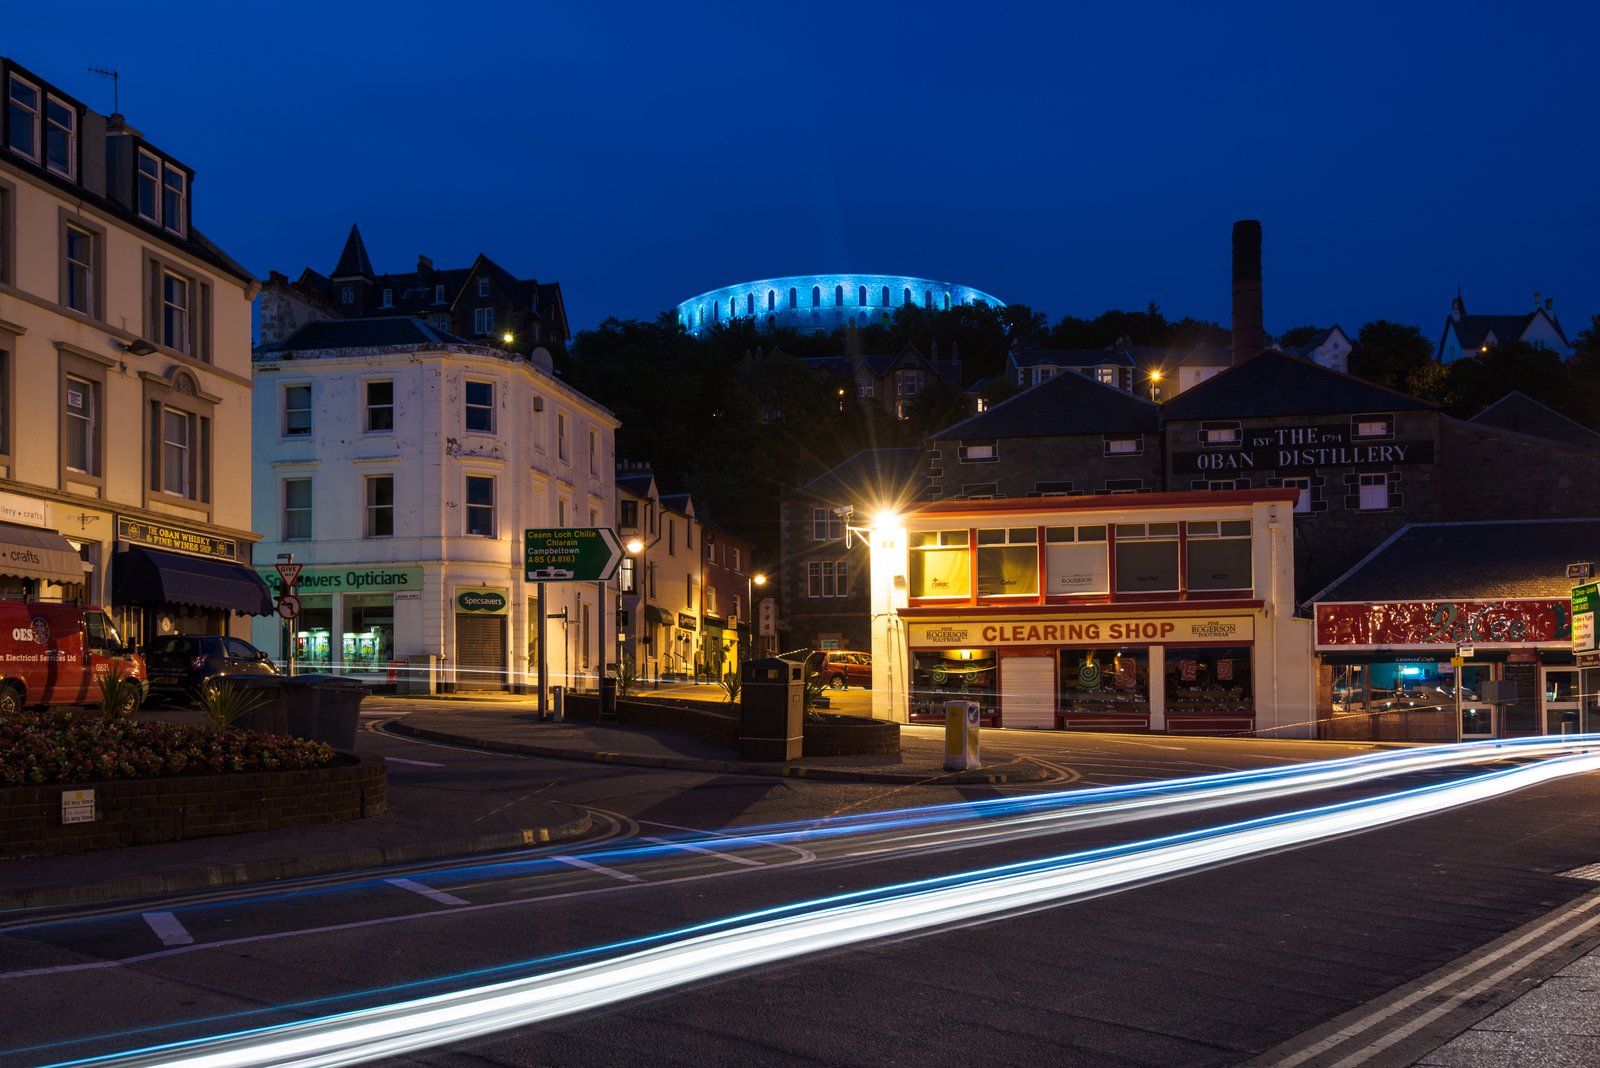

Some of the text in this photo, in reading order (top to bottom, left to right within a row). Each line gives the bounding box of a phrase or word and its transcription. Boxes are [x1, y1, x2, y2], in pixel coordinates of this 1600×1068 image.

[1274, 428, 1318, 445] THE
[1321, 434, 1342, 443] 1794
[1197, 444, 1409, 471] OBAN DISTILLERY
[23, 511, 43, 521] crafts
[147, 525, 158, 536] THE
[159, 529, 180, 540] OBAN
[181, 532, 211, 546] WHISKY
[528, 531, 552, 539] Ceann
[573, 530, 597, 538] Chille
[153, 535, 172, 546] FINE
[173, 540, 199, 552] WINES
[10, 550, 40, 565] crafts
[527, 547, 580, 556] Campbeltown
[346, 570, 408, 589] Opticians
[464, 596, 502, 606] Specsavers
[1191, 624, 1236, 633] ROGERSON
[1424, 603, 1526, 641] Dolce
[12, 628, 34, 641] OES
[926, 630, 968, 639] ROGERSON
[982, 622, 1175, 642] CLEARING SHOP
[5, 654, 39, 662] Electrical
[39, 654, 66, 662] Services
[67, 654, 77, 662] Ltd
